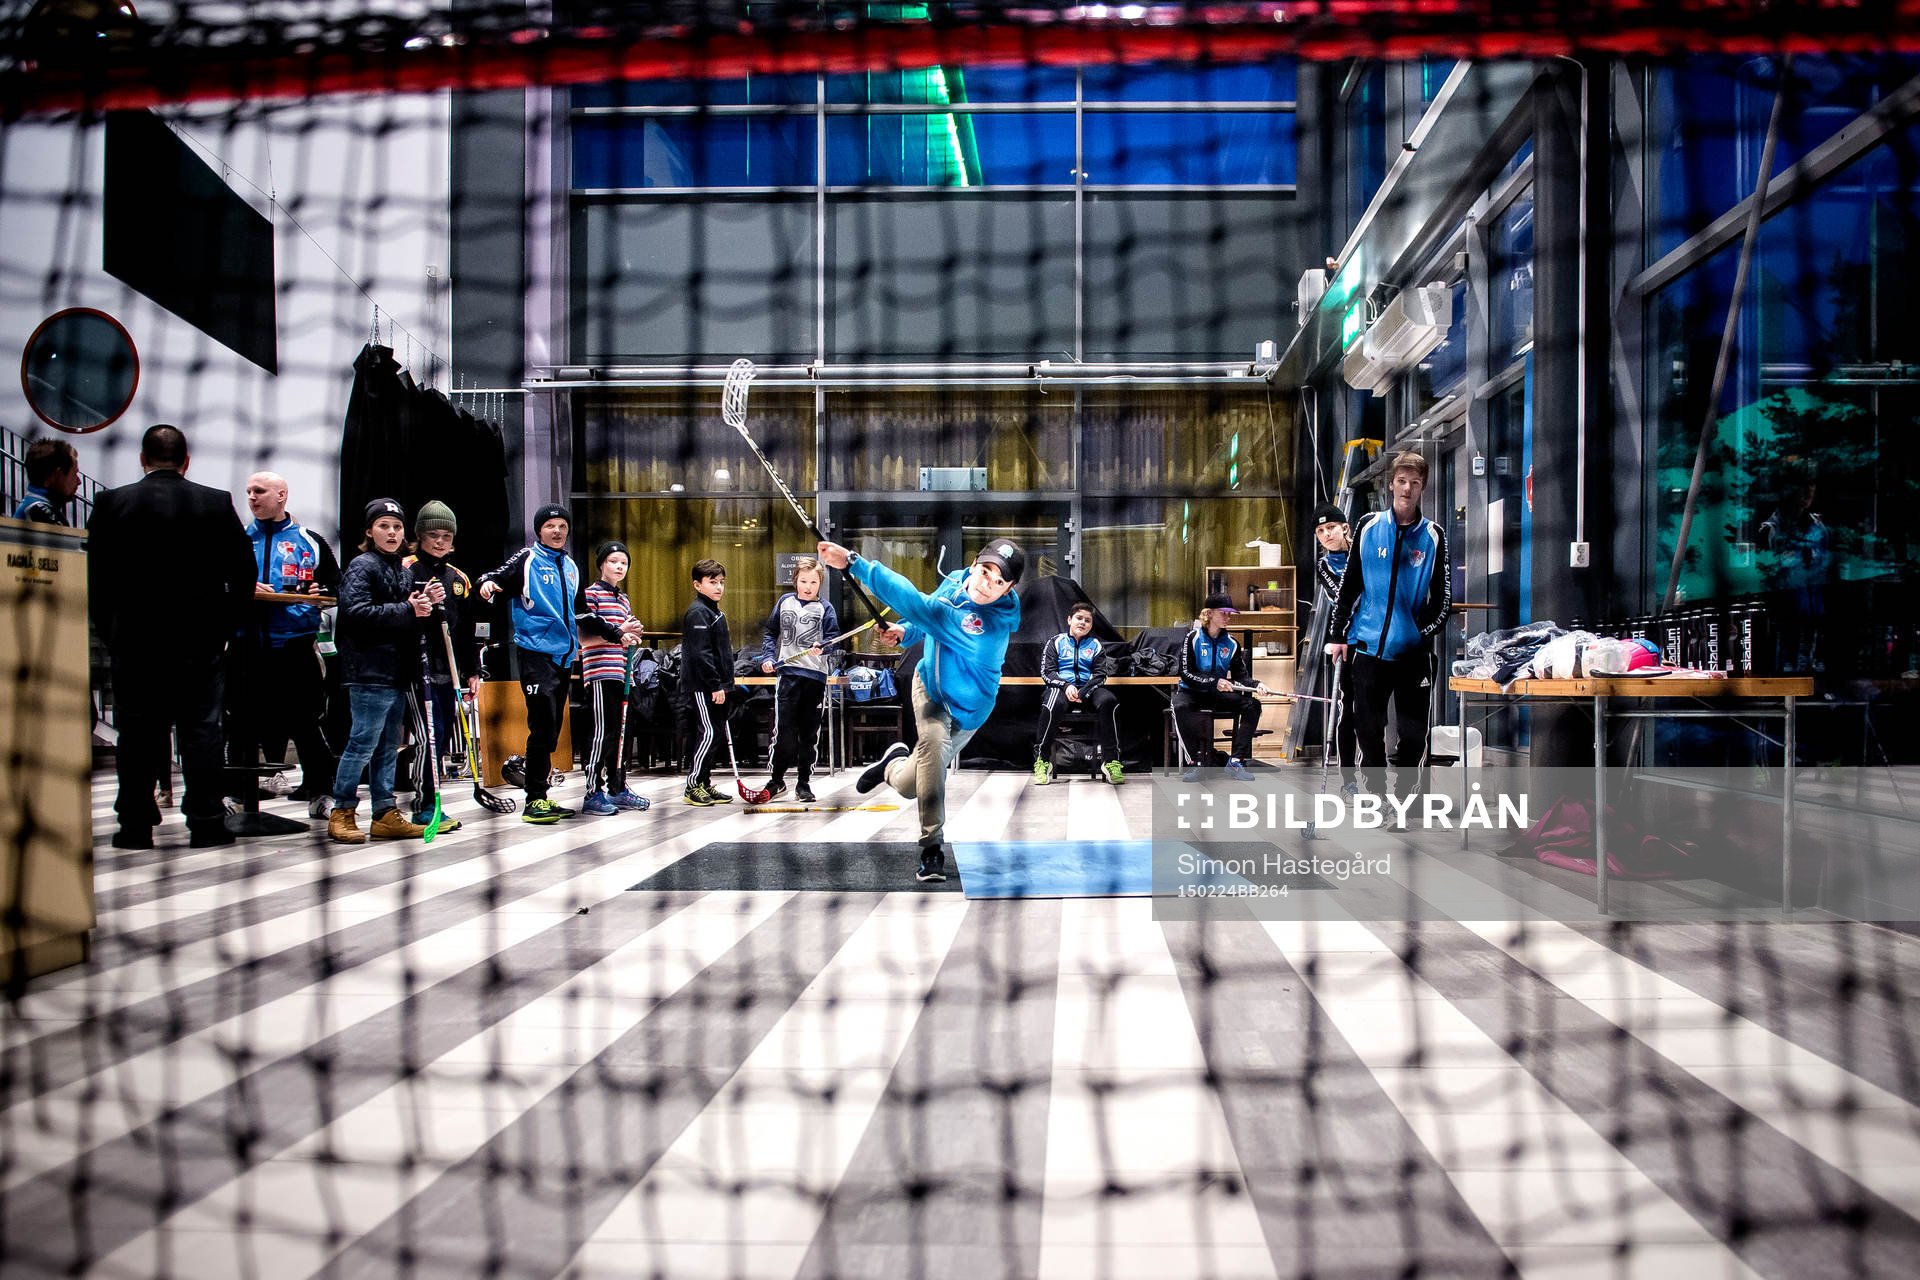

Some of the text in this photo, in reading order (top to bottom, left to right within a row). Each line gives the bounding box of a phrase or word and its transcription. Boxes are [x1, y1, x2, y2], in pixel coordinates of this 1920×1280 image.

[1377, 547, 1387, 558] 14
[542, 573, 555, 585] 97
[780, 610, 823, 648] 82
[1708, 623, 1718, 671] stadium
[1741, 618, 1752, 671] stadium
[526, 684, 540, 695] 97
